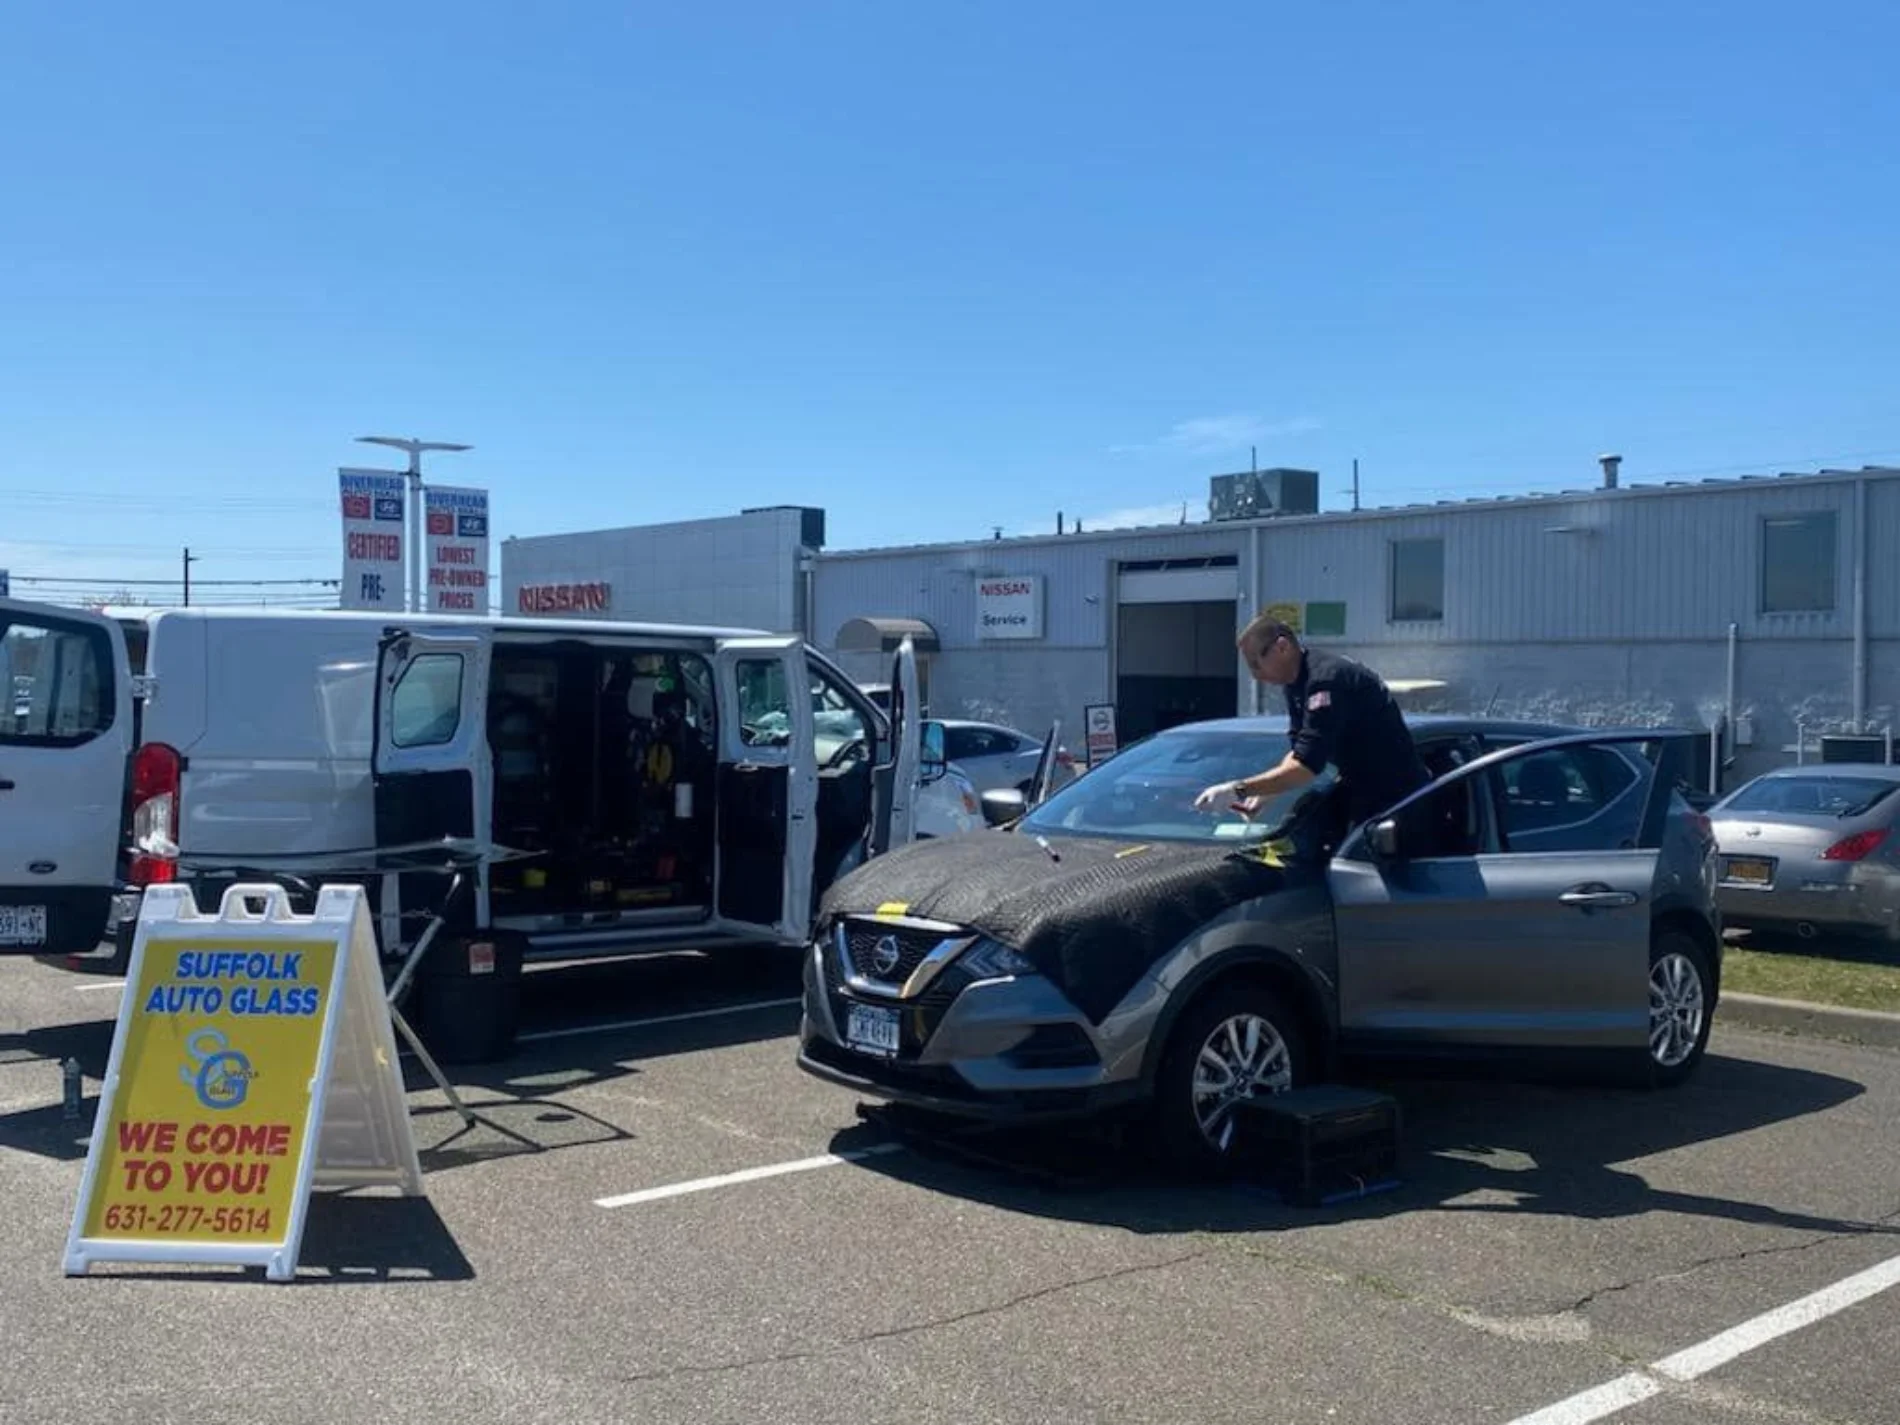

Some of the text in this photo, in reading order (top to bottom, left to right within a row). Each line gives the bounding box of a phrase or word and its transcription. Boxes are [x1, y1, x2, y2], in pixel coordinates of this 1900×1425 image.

[437, 546, 476, 564] LOWEST
[361, 573, 386, 600] PRE-
[439, 591, 474, 609] PRICES
[519, 583, 611, 613] NISSAN
[981, 583, 1030, 596] NISSAN
[983, 613, 1027, 626] Service
[176, 952, 302, 980] SUFFOLK
[145, 986, 319, 1015] AUTO GLASS
[119, 1122, 291, 1156] WE COME
[124, 1160, 270, 1195] TO YOU!
[105, 1204, 271, 1233] 631-277-5614
